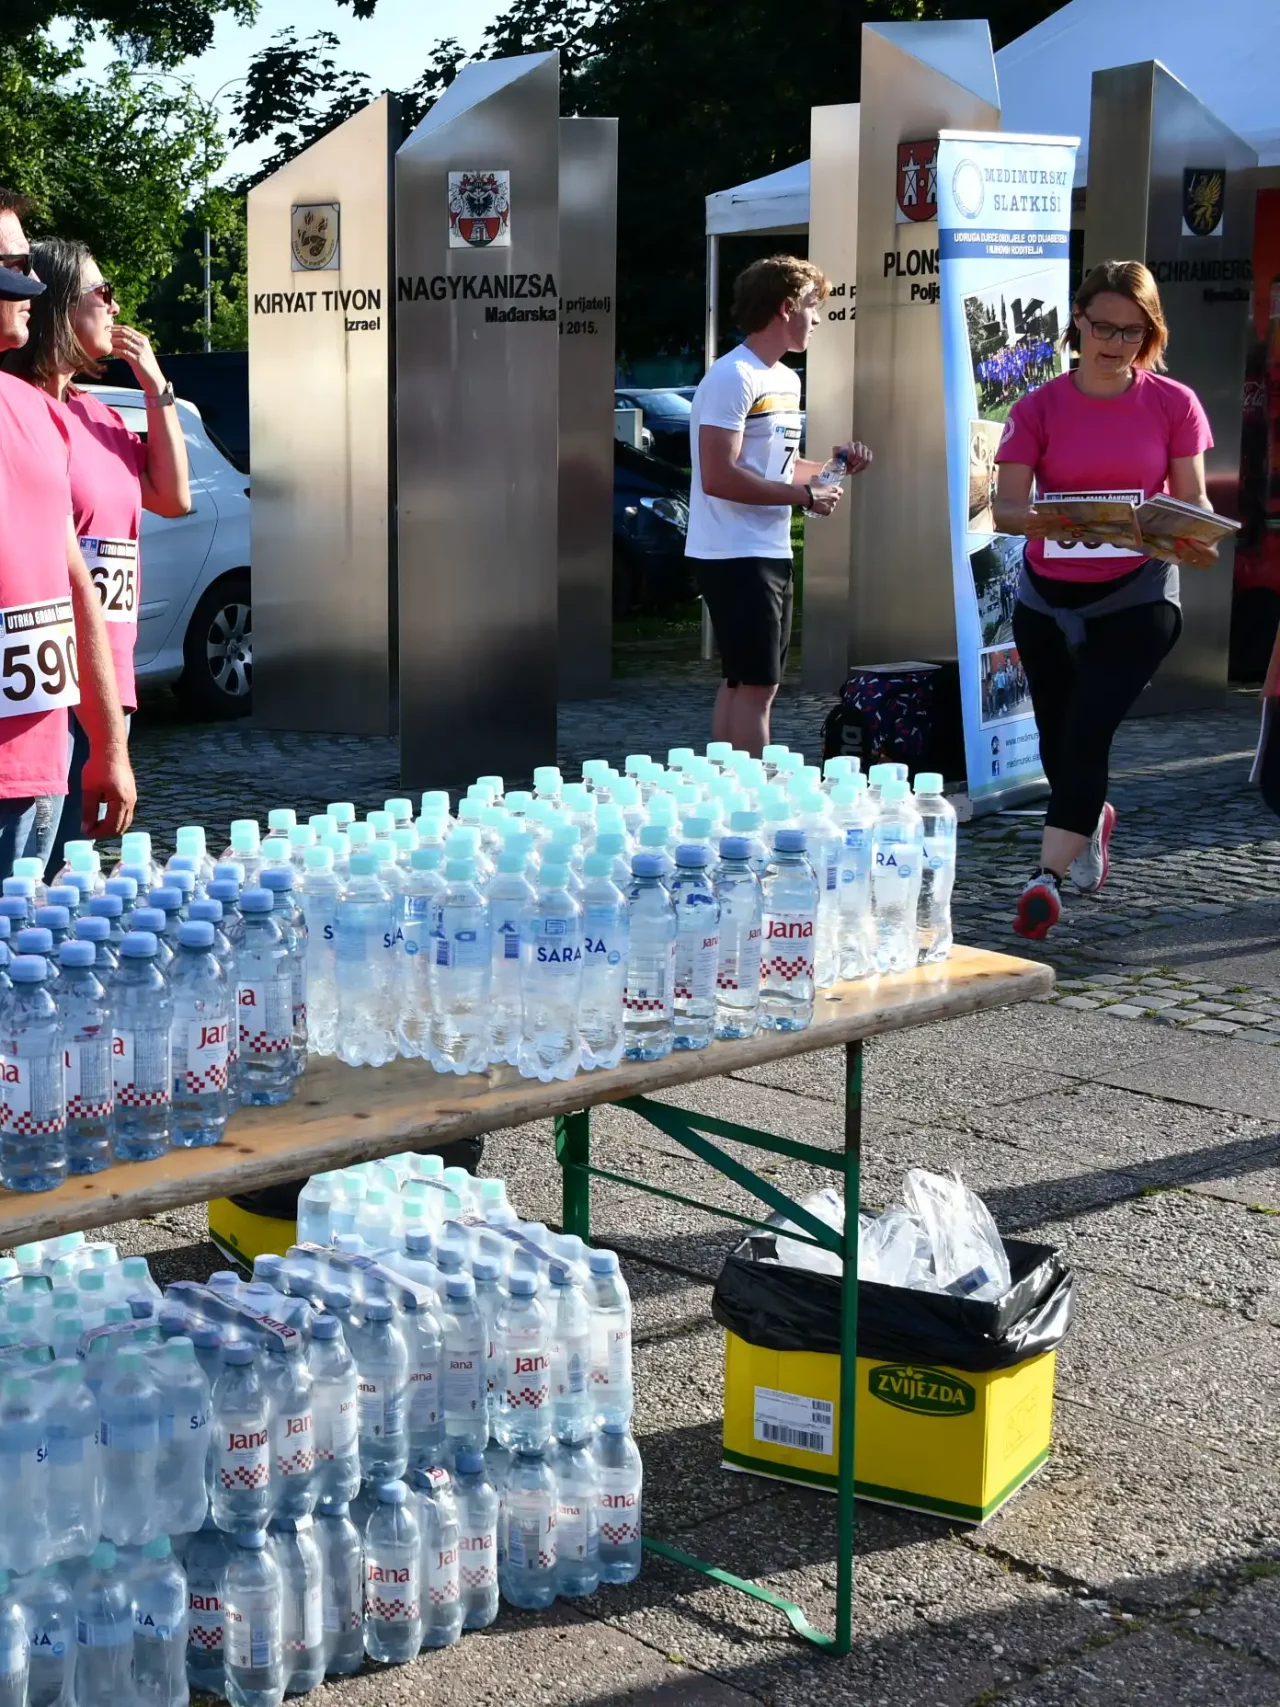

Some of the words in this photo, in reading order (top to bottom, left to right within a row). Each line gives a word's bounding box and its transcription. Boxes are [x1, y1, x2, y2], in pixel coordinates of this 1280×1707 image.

[397, 273, 558, 301] NAGYKANIZSA
[254, 289, 317, 315] KIRYAT
[321, 289, 381, 311] TIVON
[566, 296, 611, 313] prijatelj
[344, 317, 381, 332] Izrael
[485, 305, 557, 324] Mađarska
[90, 566, 134, 611] 625
[7, 612, 35, 629] UTRKA
[2, 635, 80, 702] 590
[765, 920, 814, 939] Jana
[537, 946, 582, 963] SARA
[256, 1315, 297, 1338] Jana
[449, 1360, 473, 1370] Jana
[513, 1354, 550, 1375] Jana
[878, 1374, 966, 1406] ZVIJEZDA
[227, 1429, 268, 1451] Jana
[367, 1565, 410, 1583] Jana
